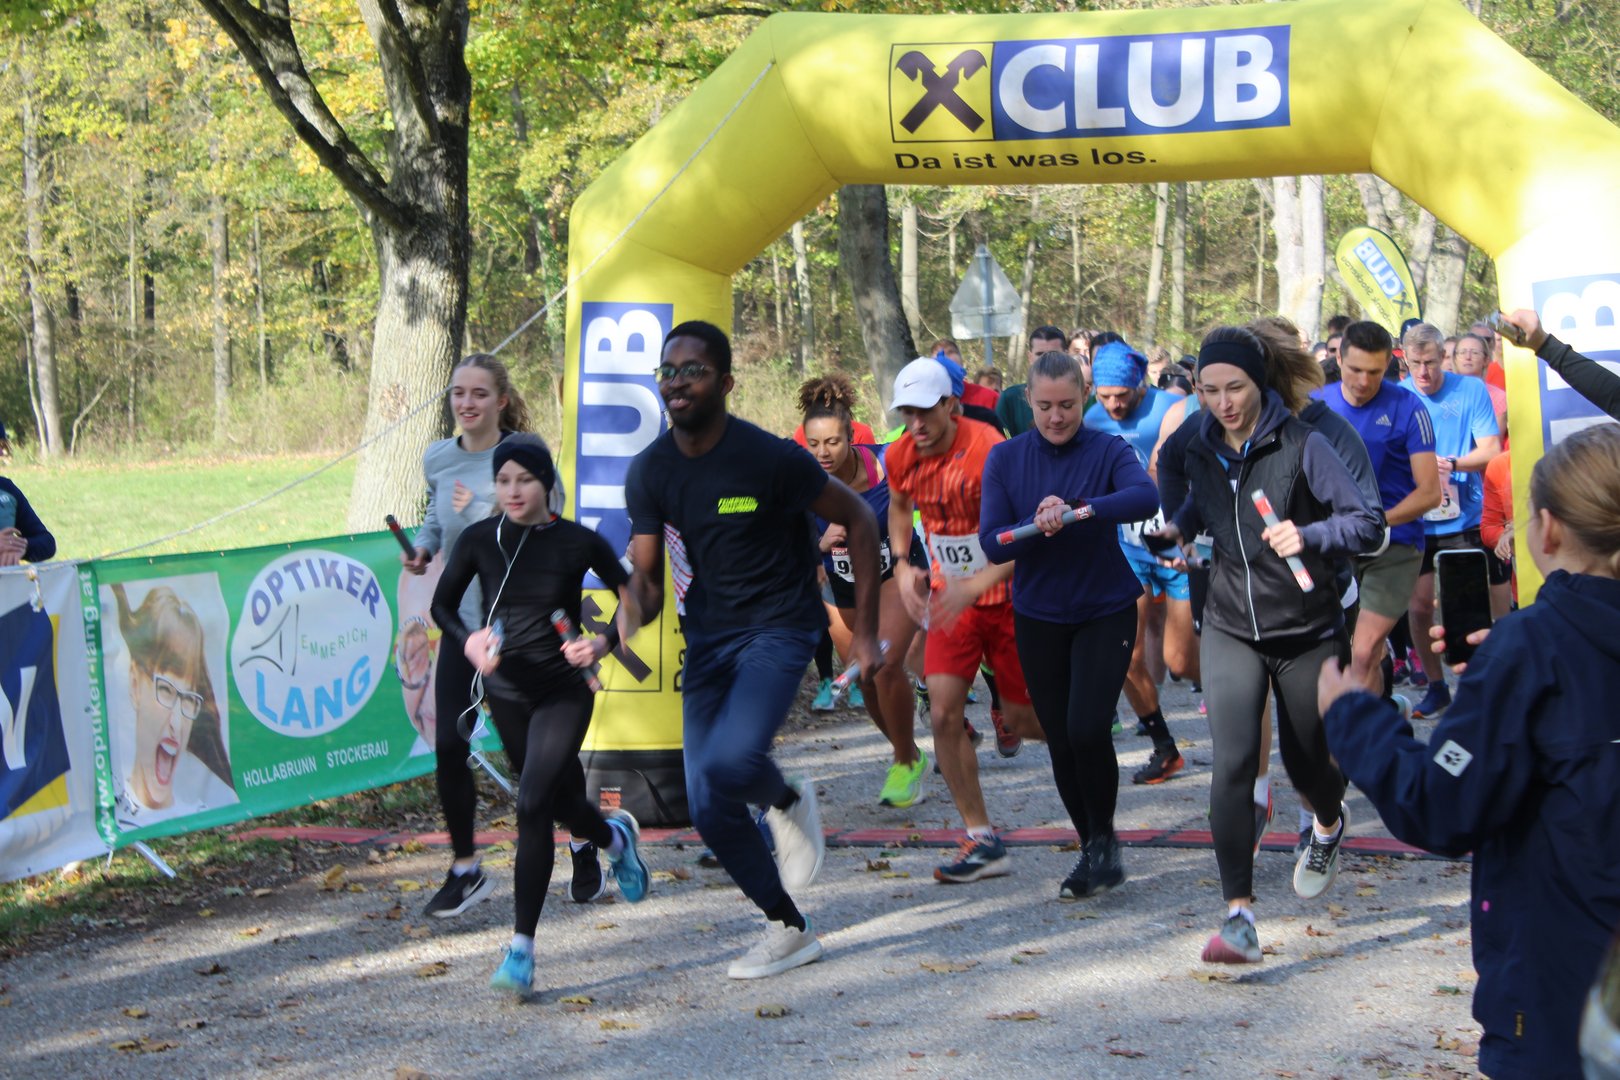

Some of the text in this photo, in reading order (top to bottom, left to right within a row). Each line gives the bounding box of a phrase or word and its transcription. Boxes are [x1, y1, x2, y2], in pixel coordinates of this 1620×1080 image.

[998, 34, 1282, 133] CLUB
[895, 149, 1157, 170] Da ist was los.
[937, 545, 973, 564] 103
[252, 558, 380, 626] OPTIKER
[301, 628, 368, 659] EMMERICH
[81, 570, 117, 843] www.optiker-lang.at
[256, 655, 370, 730] LANG
[243, 739, 389, 788] HOLLABRUNN STOCKERAU
